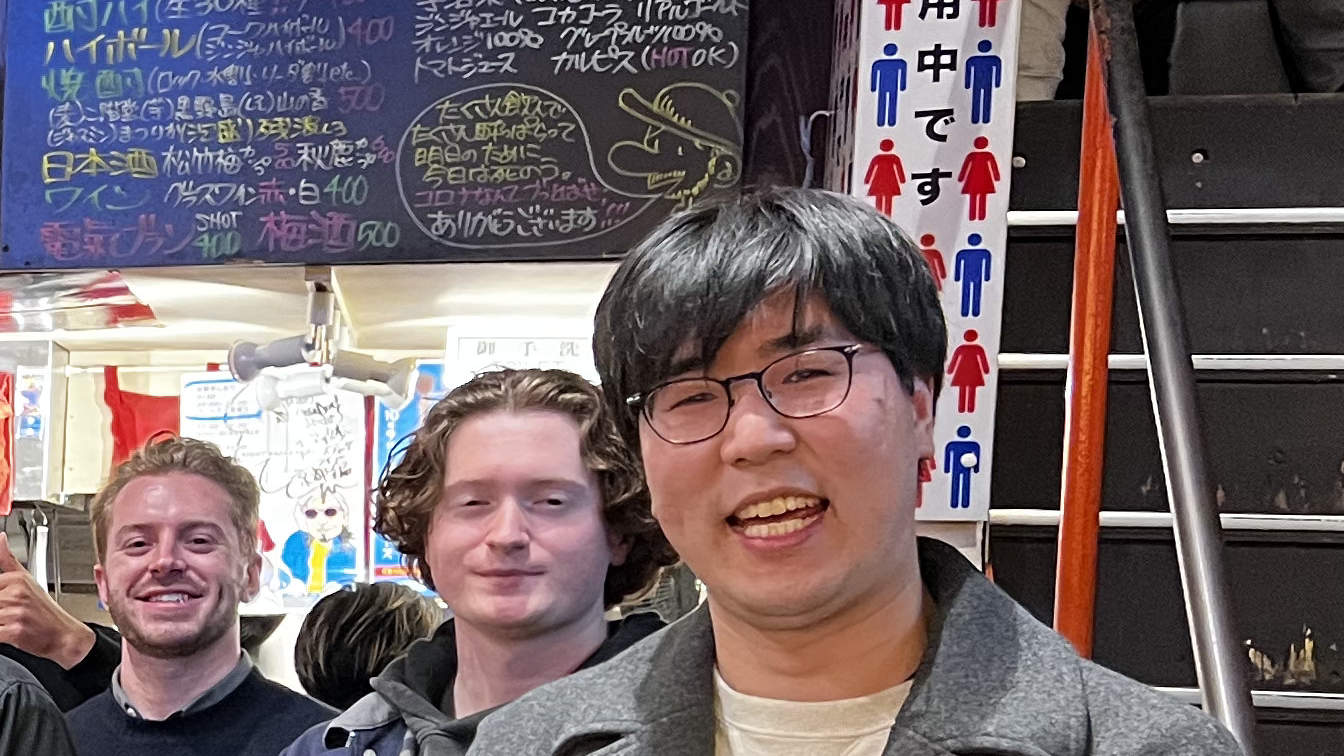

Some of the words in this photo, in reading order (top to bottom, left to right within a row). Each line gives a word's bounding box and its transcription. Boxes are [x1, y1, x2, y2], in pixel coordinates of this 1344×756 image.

[45, 27, 196, 65] ハイボール
[42, 147, 159, 184] 日本酒
[45, 184, 151, 213] ワイン
[323, 174, 368, 206] 400
[195, 211, 243, 231] SHOT
[257, 210, 358, 253] 梅酒
[358, 221, 400, 249] 500
